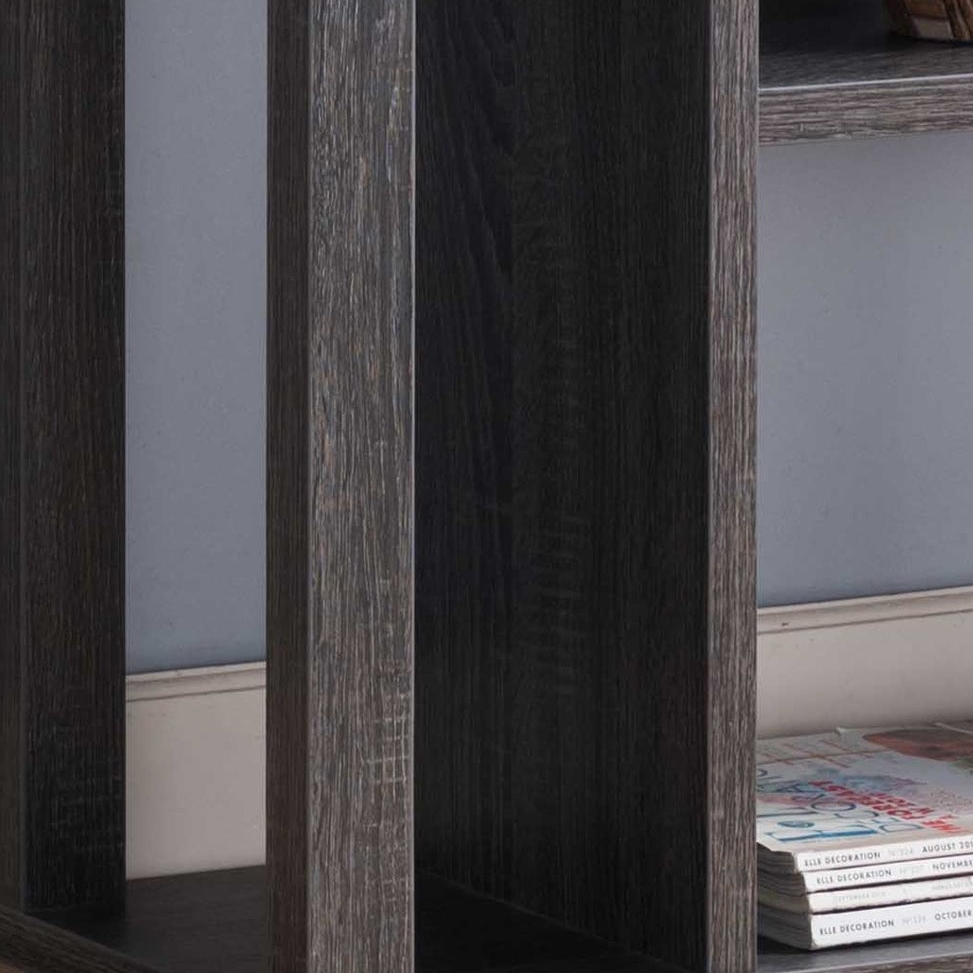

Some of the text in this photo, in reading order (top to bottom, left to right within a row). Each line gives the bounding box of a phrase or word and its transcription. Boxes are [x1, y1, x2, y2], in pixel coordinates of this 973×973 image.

[804, 858, 821, 868] ELLE
[825, 851, 881, 865] DECORATION
[922, 843, 956, 853] AUGUST
[816, 875, 834, 885] ELLE
[837, 869, 892, 883] DECORATION
[819, 925, 837, 936] ELLE
[840, 919, 895, 933] DECORATION
[934, 910, 972, 921] OCTOBER
